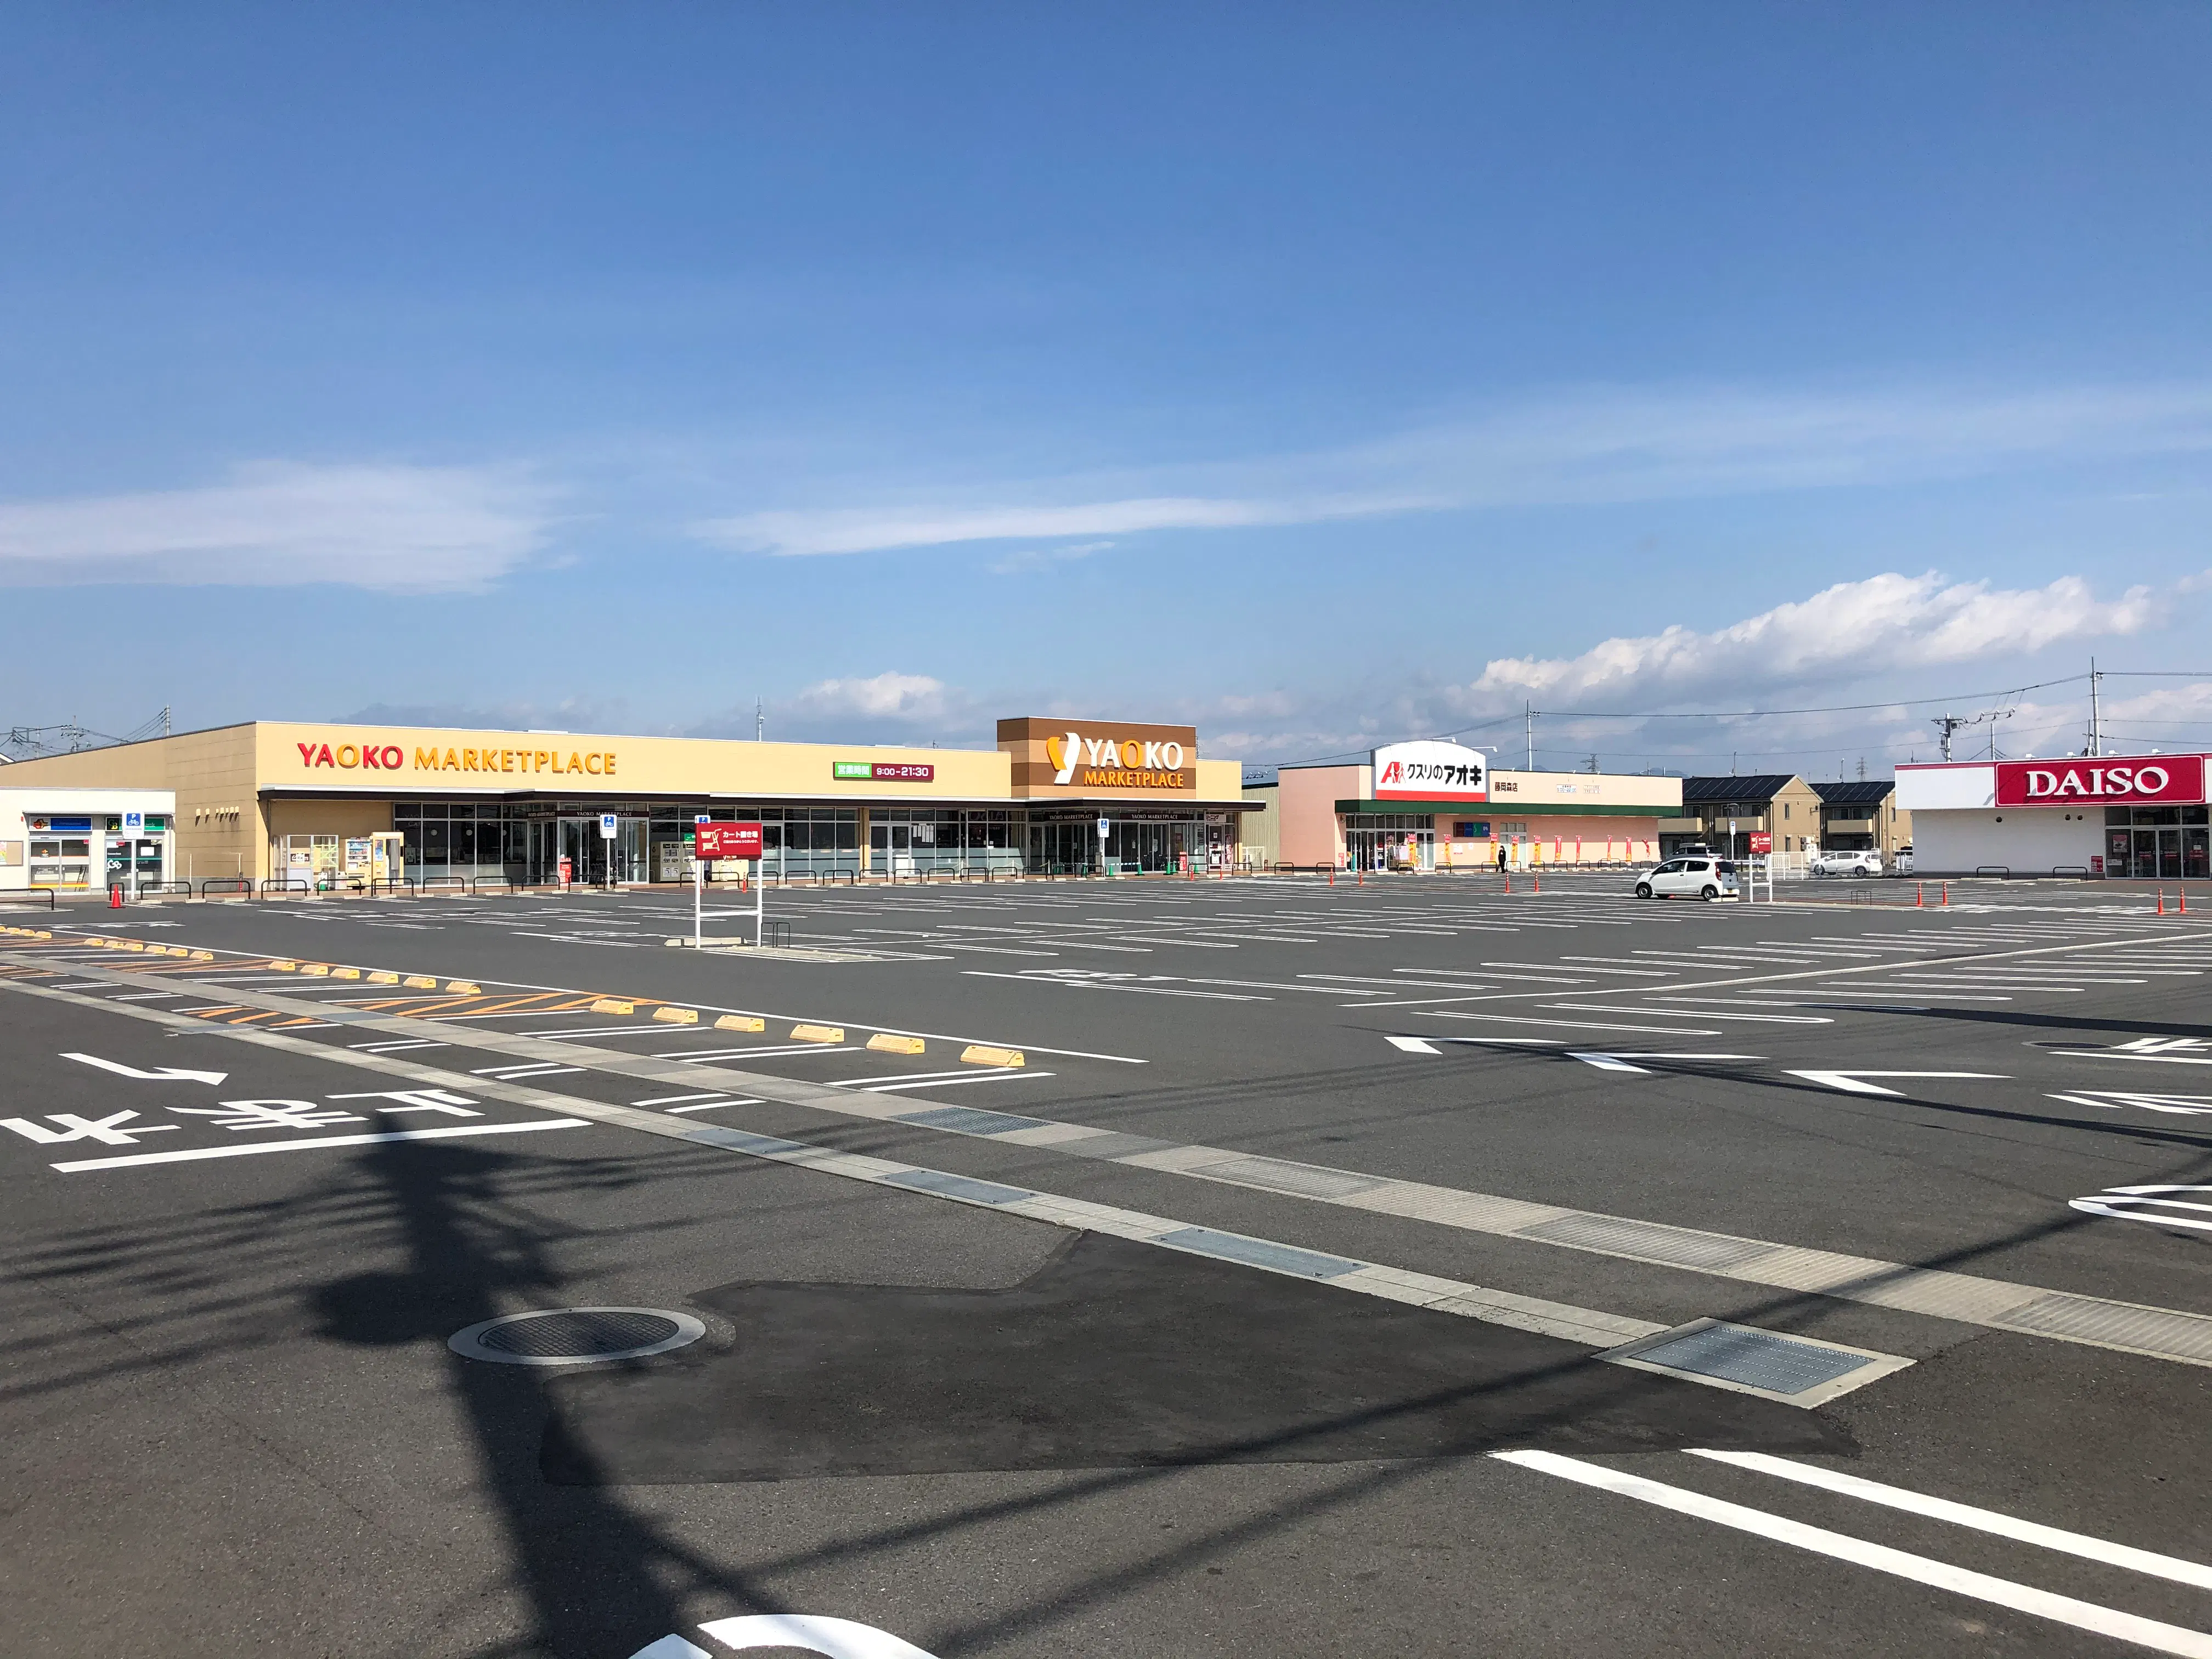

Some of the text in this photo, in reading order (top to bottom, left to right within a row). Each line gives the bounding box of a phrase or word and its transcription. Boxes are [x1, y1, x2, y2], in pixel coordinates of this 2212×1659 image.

[297, 743, 617, 775] YAOKO MARKETPLACE
[1084, 738, 1184, 771] YAOKO
[837, 764, 870, 776] 営業時間
[1084, 770, 1184, 788] MARKETPLACE
[1407, 764, 1482, 786] クスリのアオキ
[2025, 766, 2169, 797] DAISO
